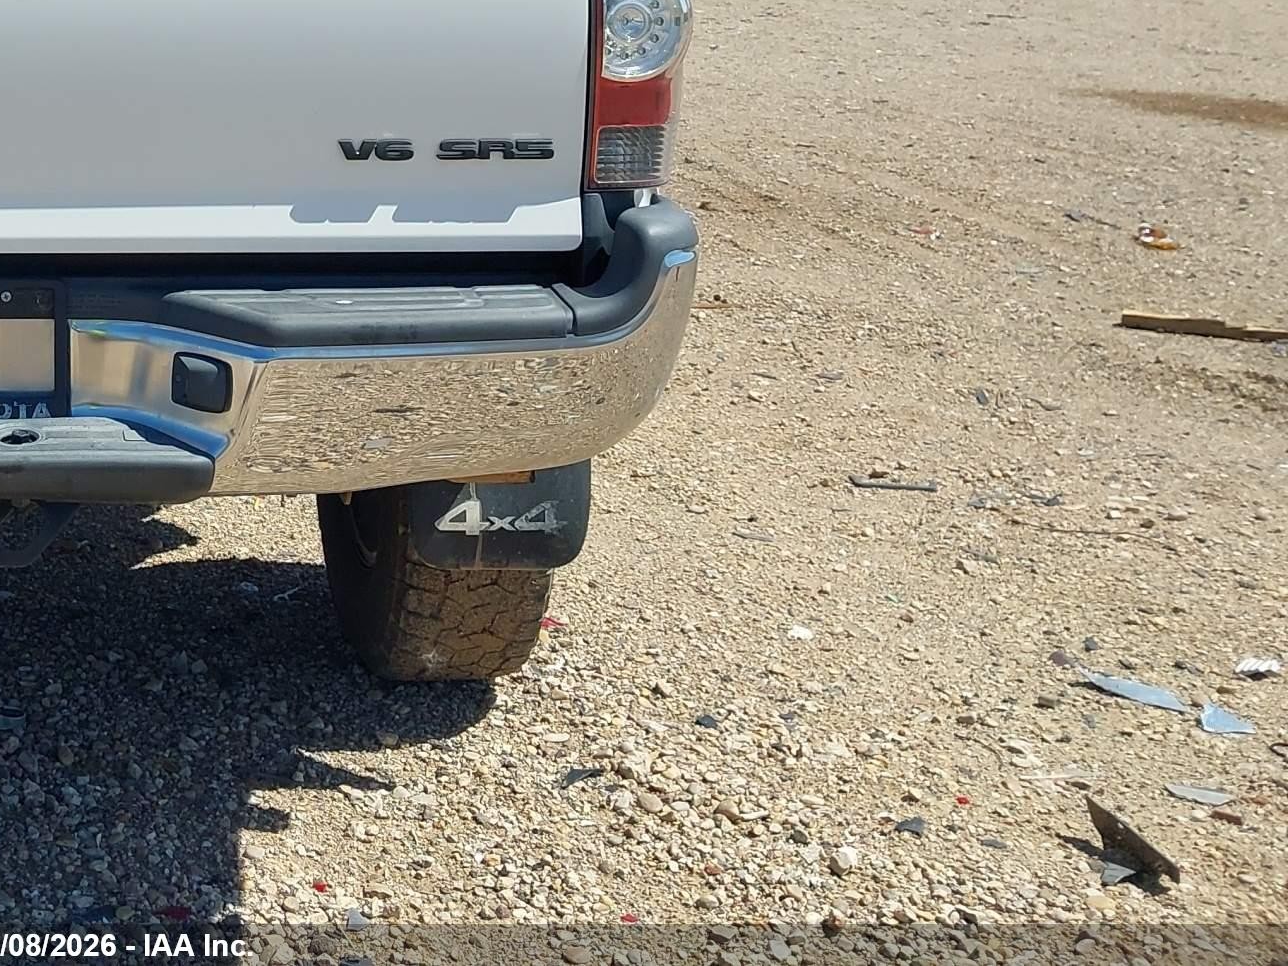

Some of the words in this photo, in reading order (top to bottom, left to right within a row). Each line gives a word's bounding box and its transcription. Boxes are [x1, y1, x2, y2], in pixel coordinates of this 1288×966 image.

[337, 138, 415, 161] V6
[436, 138, 554, 160] SR5
[434, 499, 568, 536] 4x4
